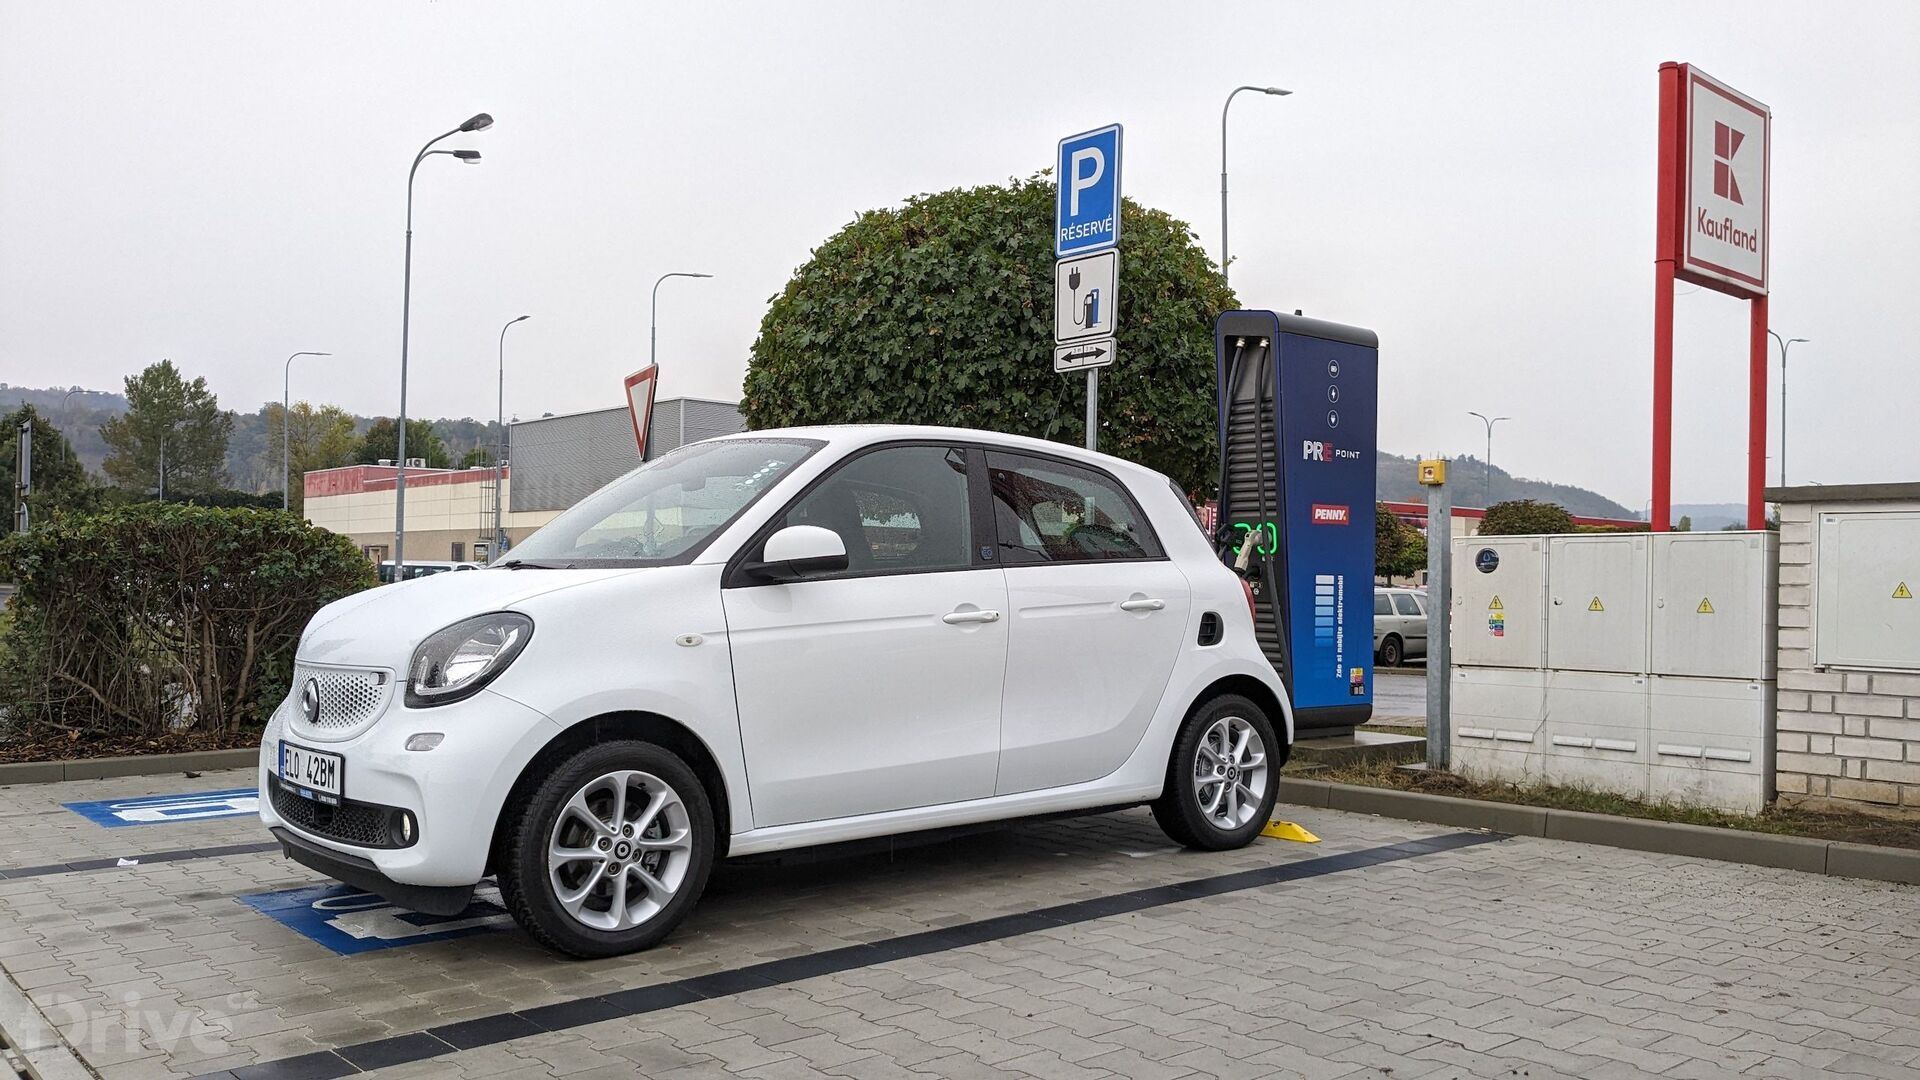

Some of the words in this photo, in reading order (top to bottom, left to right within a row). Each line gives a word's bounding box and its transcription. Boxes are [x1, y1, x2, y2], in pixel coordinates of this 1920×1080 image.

[1070, 147, 1105, 217] P
[1061, 214, 1113, 242] RÉSERVÉ
[1697, 206, 1757, 253] Kaufland
[1303, 440, 1333, 461] PRE
[1335, 449, 1360, 459] POINT
[307, 755, 335, 789] 42BM
